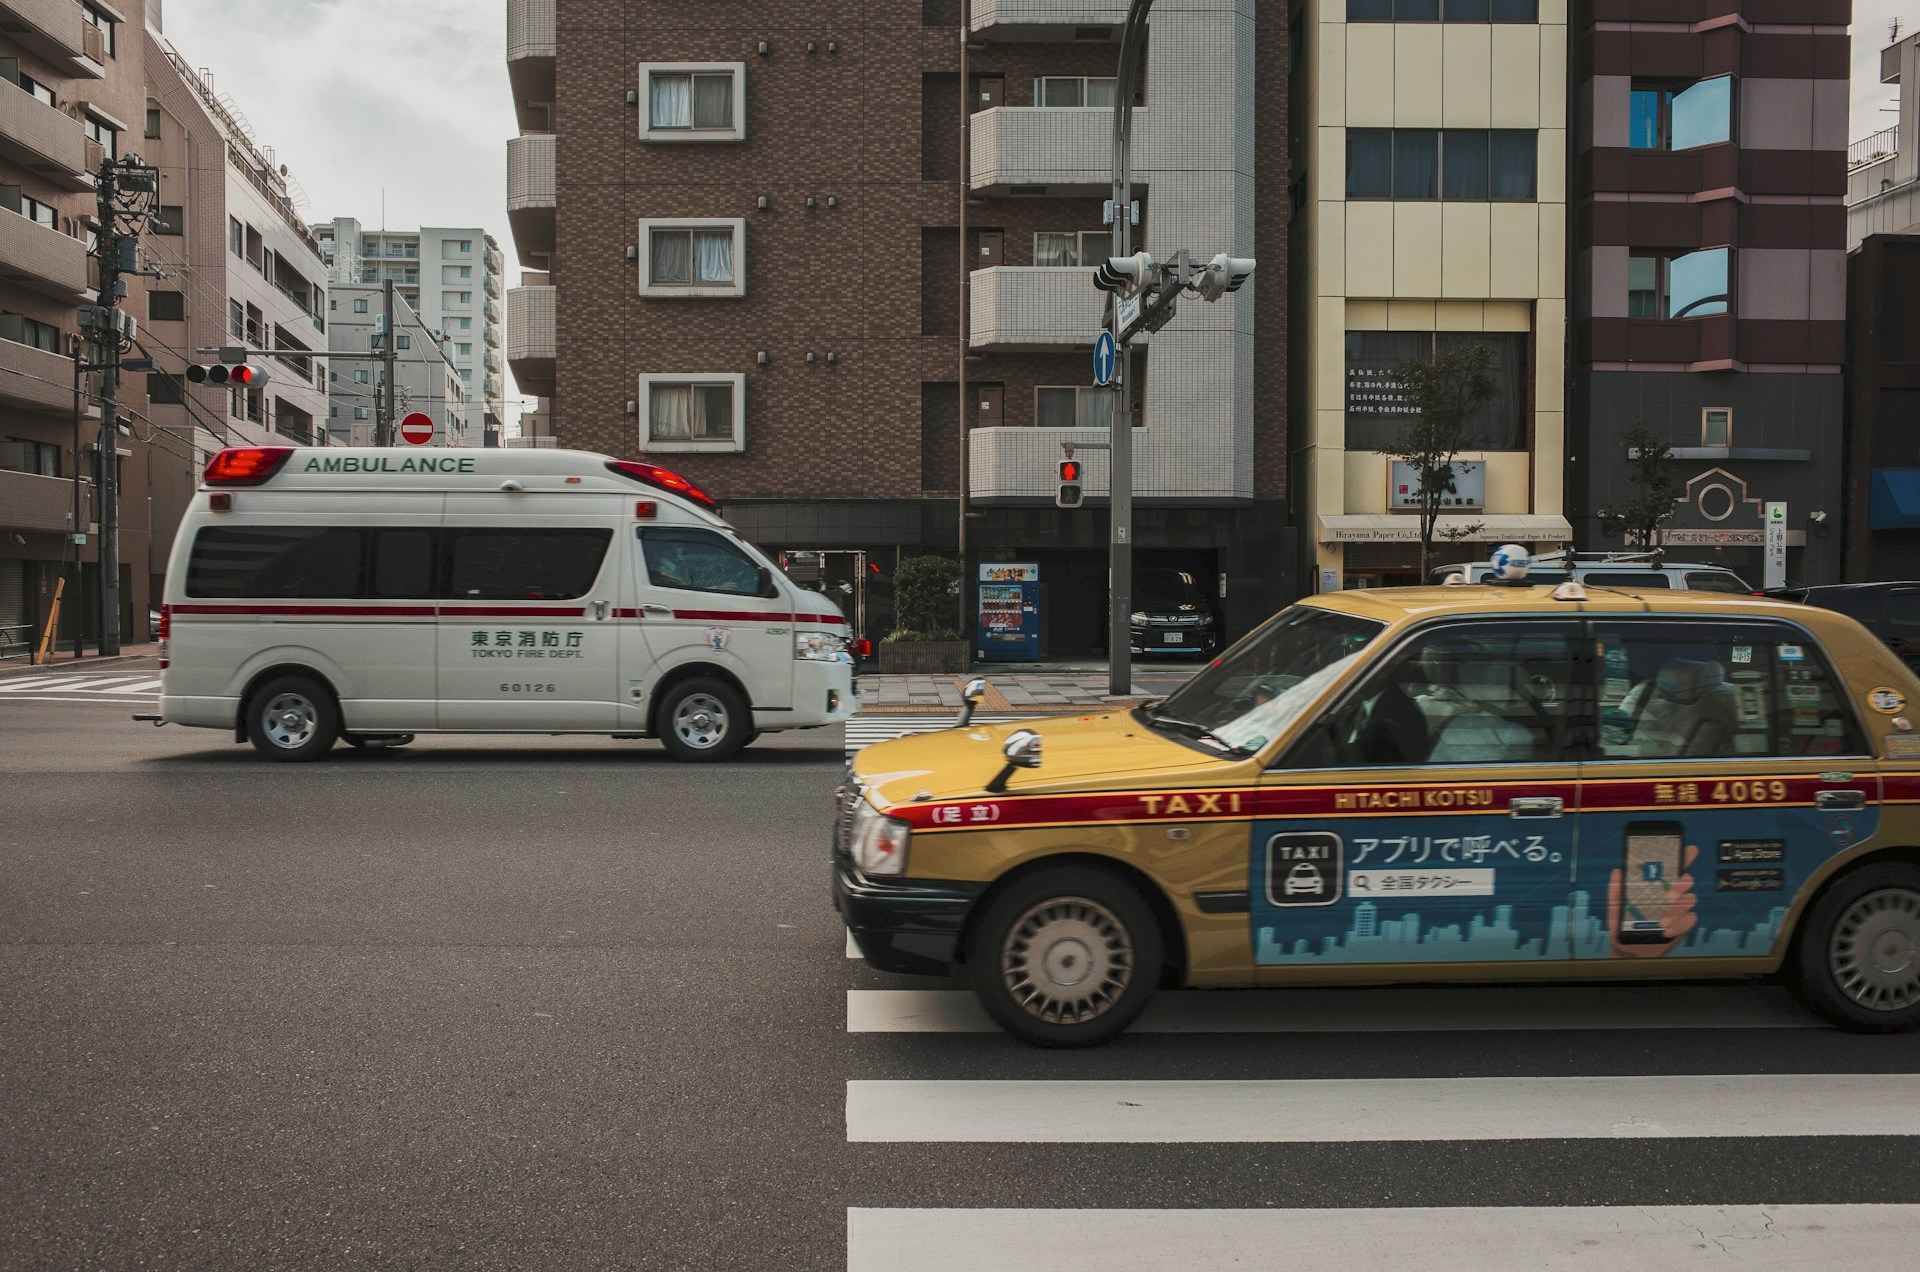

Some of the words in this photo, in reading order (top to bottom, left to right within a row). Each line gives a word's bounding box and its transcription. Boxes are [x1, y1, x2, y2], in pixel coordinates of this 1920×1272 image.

[304, 457, 476, 473] AMBULANCE
[1373, 530, 1395, 541] Paper
[471, 630, 584, 647] 東京消防庁
[471, 649, 513, 658] TOKYO
[517, 649, 545, 658] FIRE
[499, 683, 556, 693] 60126
[1334, 791, 1420, 809] HITACHI
[1423, 789, 1493, 807] KOTSU
[1654, 783, 1698, 802] 無線
[1711, 780, 1787, 802] 4069
[1139, 794, 1241, 814] TAXI
[1279, 845, 1329, 860] TAXI
[1351, 834, 1563, 864] アプリで呼べる。
[1380, 874, 1473, 891] 全国タクシー
